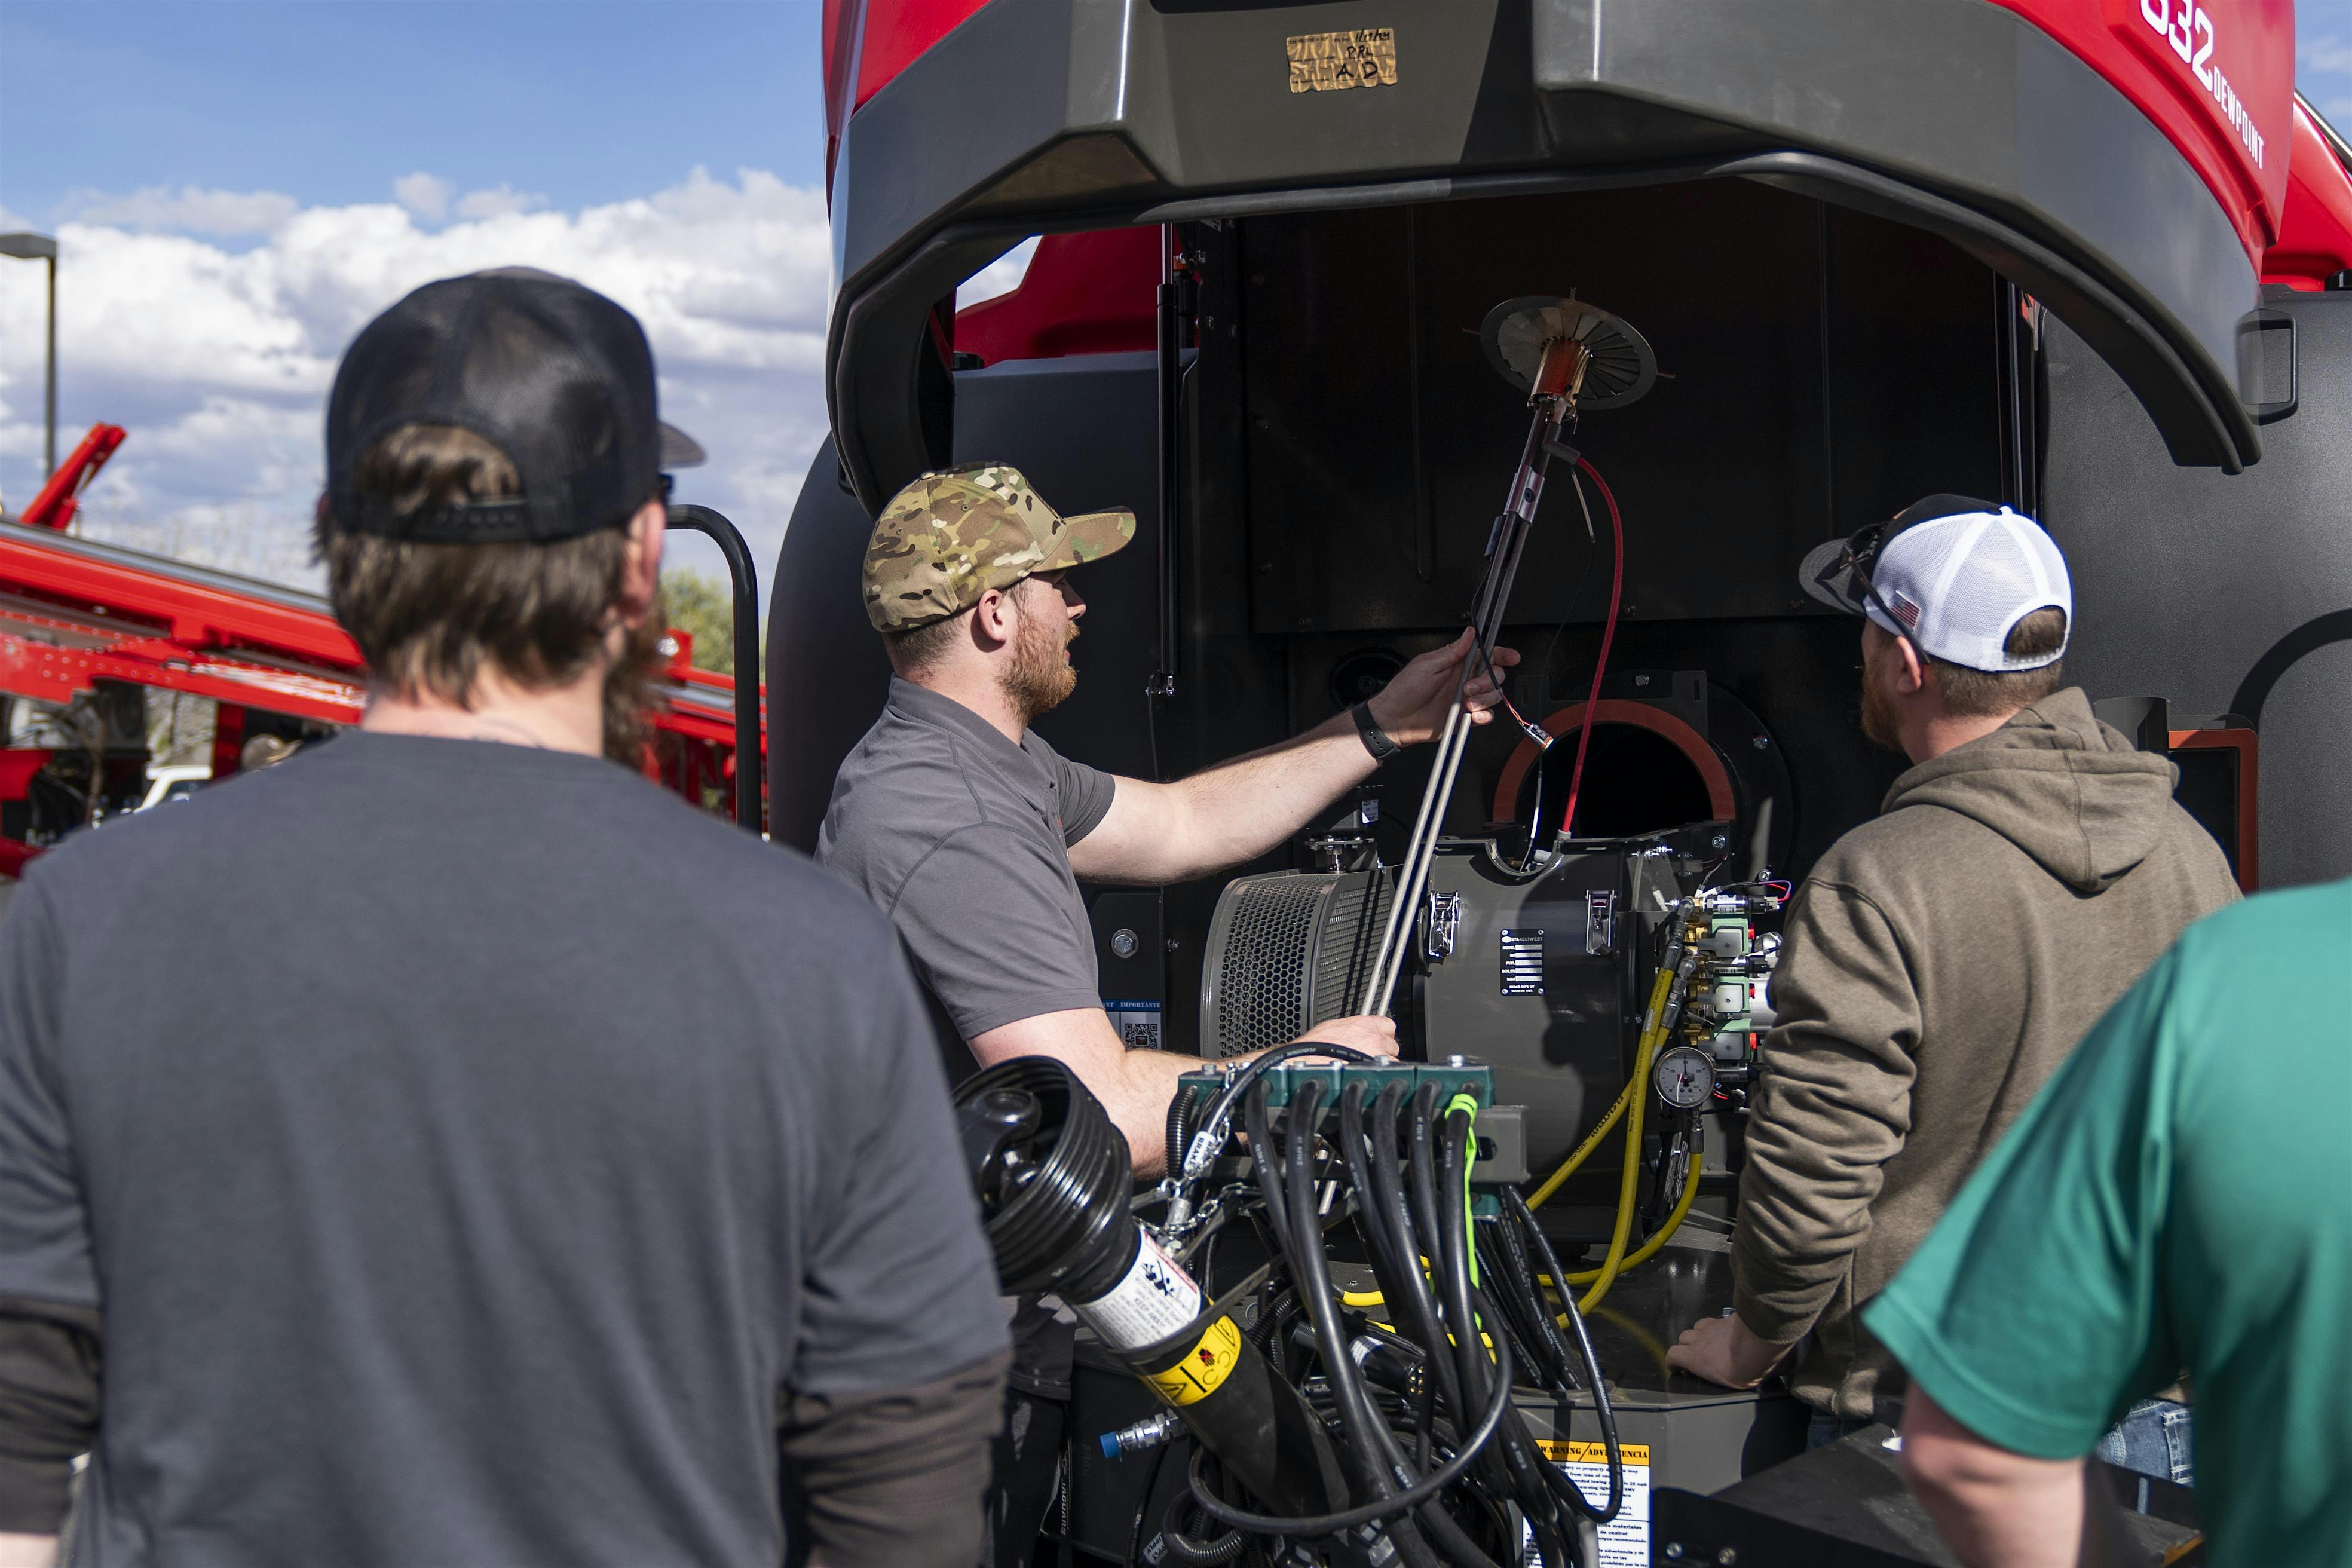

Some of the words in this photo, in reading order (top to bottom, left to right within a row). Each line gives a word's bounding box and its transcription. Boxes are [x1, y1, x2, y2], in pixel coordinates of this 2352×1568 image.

[2213, 65, 2265, 170] DEWPOINT
[1189, 1137, 1204, 1165] BRAKE
[1539, 1446, 1581, 1455] WARNING
[1588, 1448, 1648, 1459] ADVTENCIA
